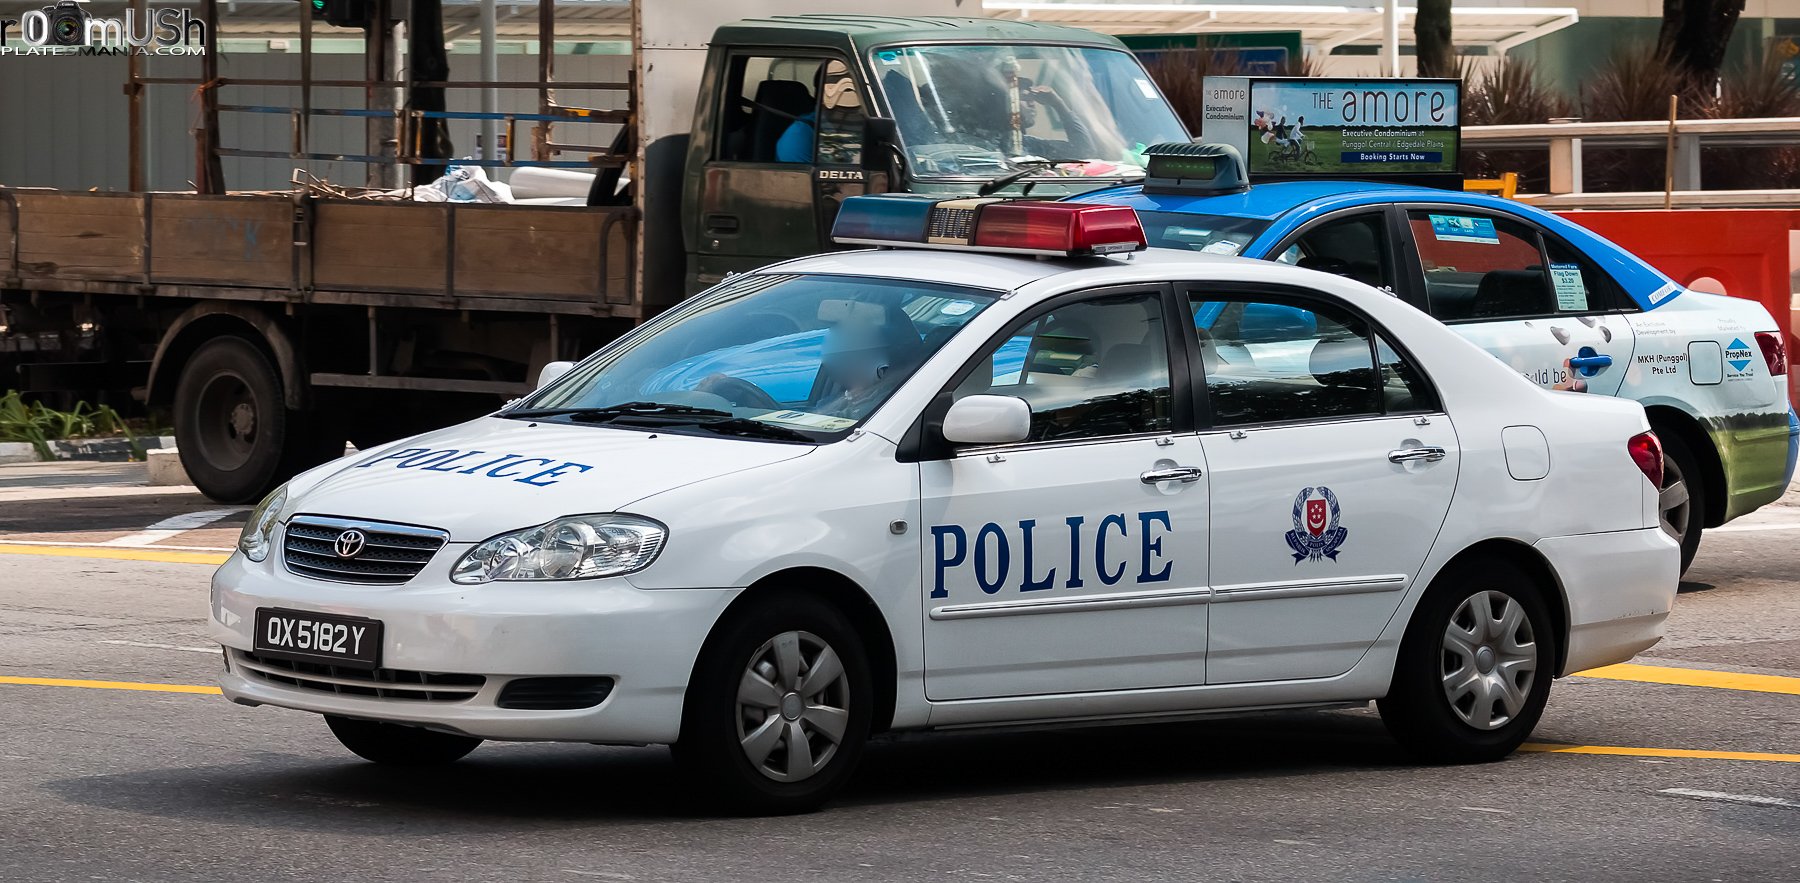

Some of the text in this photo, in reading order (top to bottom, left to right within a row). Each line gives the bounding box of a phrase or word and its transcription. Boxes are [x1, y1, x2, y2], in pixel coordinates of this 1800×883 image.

[1213, 90, 1245, 100] amore
[1312, 91, 1445, 123] THE amore
[1342, 129, 1372, 137] Executive
[1374, 129, 1417, 137] Condominium
[1342, 140, 1367, 149] Punggol
[1368, 140, 1391, 148] Central
[1397, 140, 1425, 149] Edgedale
[1426, 140, 1444, 148] Plains
[1360, 153, 1387, 161] Booking
[819, 170, 864, 179] DELTA
[1637, 353, 1687, 364] MKH (Punggol)
[1725, 350, 1752, 359] PropNex
[1652, 365, 1676, 375] Pte Ltd
[1553, 368, 1567, 383] be
[355, 448, 594, 487] POLICE
[930, 510, 1174, 599] POLICE
